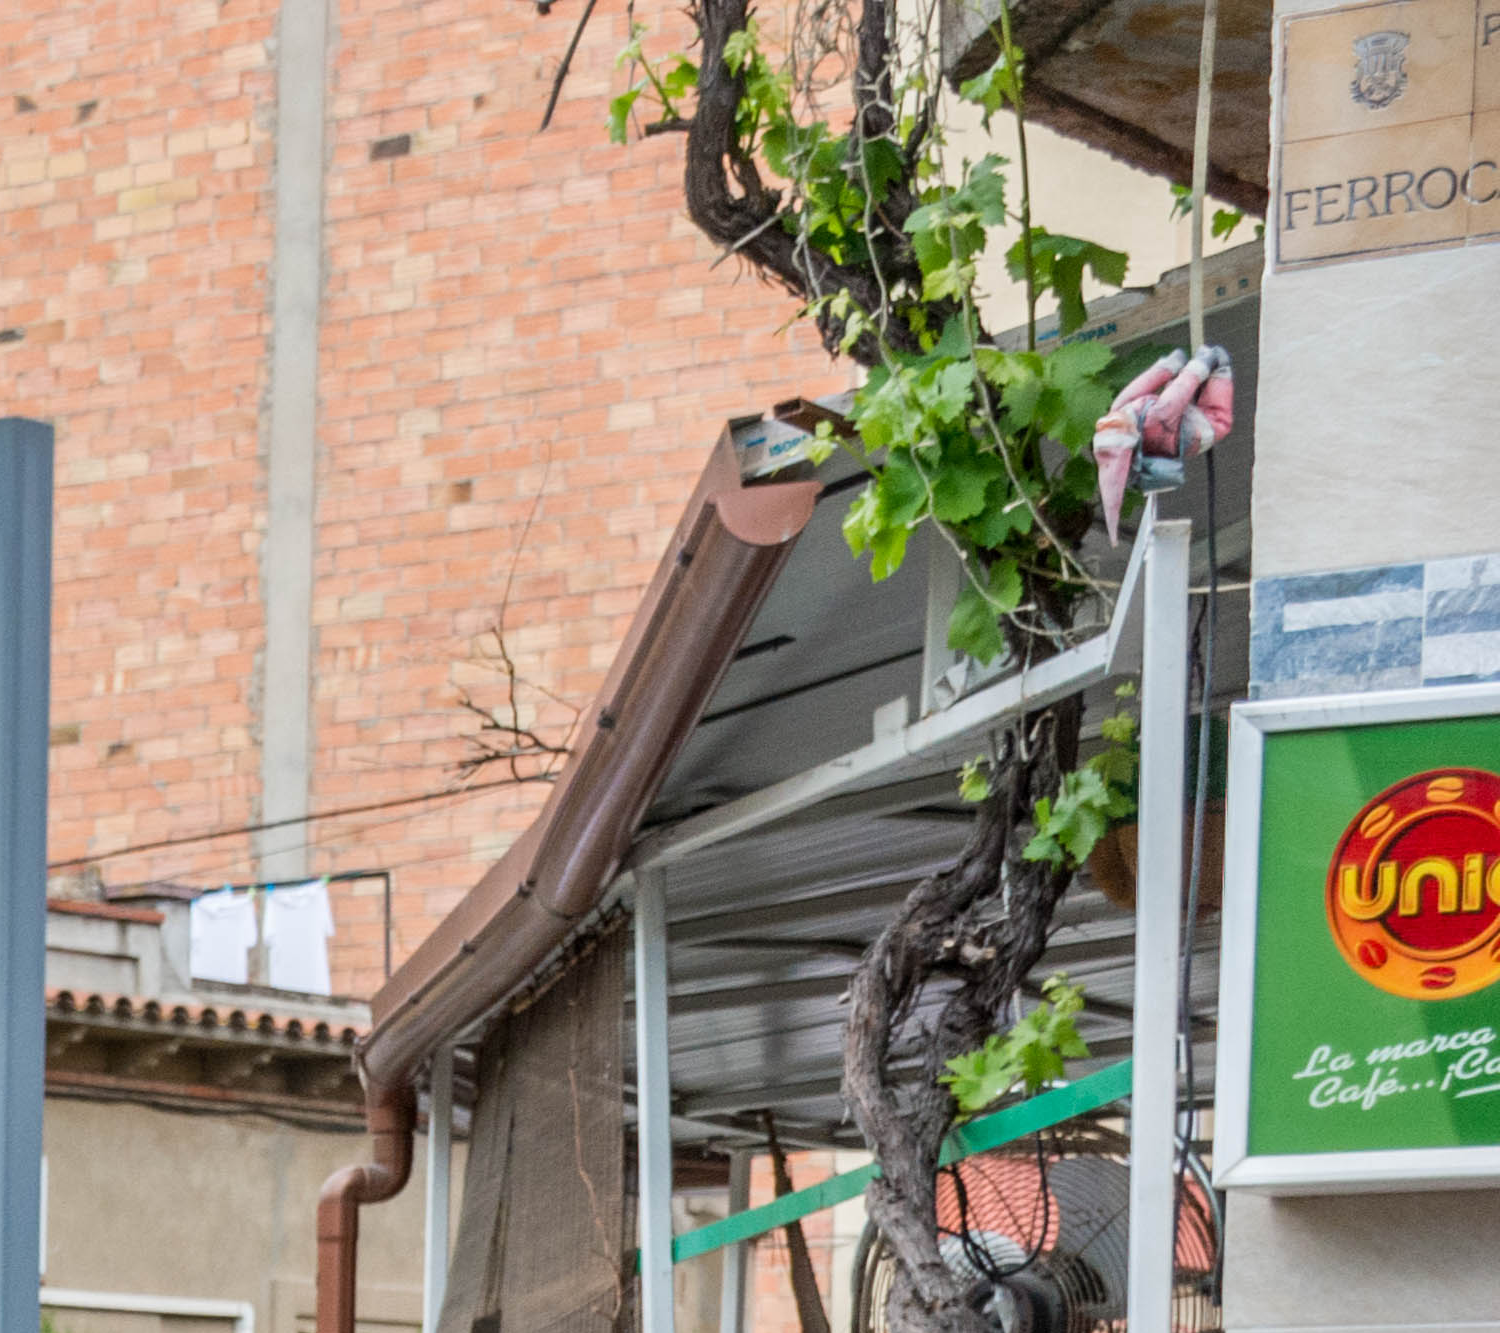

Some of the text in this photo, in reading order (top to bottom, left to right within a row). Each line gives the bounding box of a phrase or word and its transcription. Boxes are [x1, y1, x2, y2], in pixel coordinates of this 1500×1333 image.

[1284, 160, 1500, 232] FERROC
[1292, 1026, 1497, 1080] La marca
